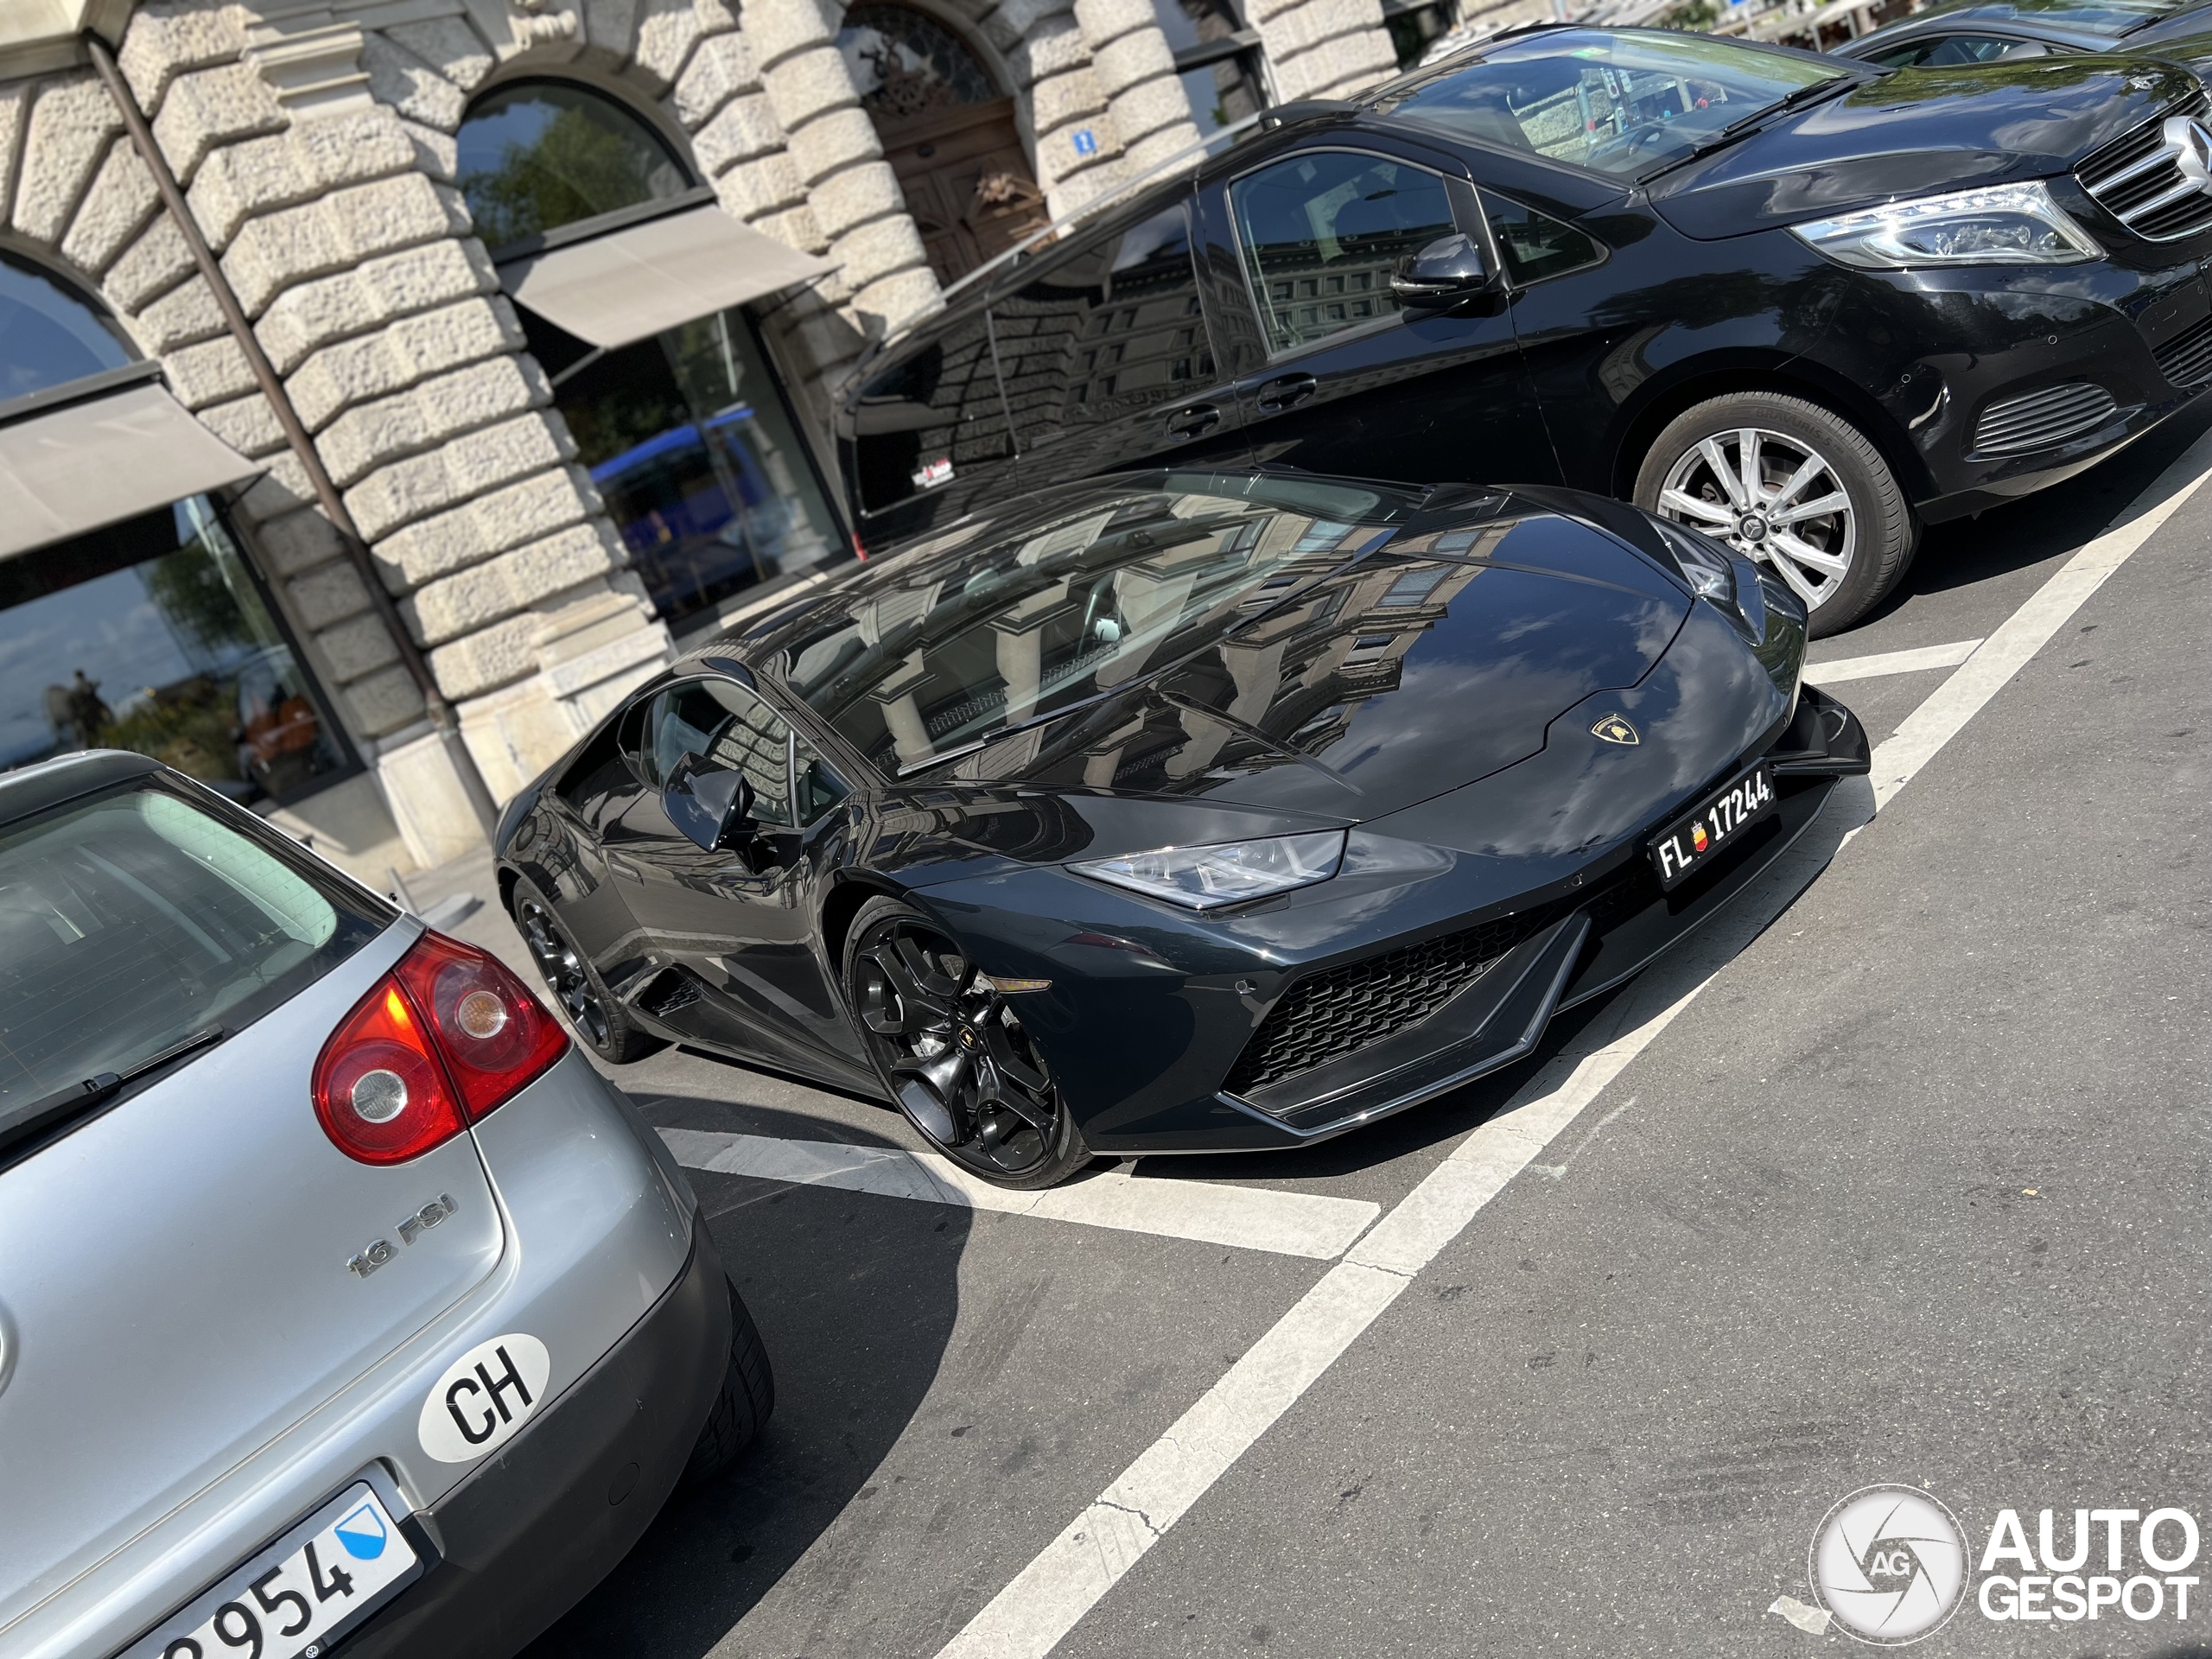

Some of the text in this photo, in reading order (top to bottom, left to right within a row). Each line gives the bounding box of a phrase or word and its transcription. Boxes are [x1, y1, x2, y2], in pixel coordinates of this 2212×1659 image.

[1756, 410, 1821, 438] BRAVURIS
[1822, 438, 1831, 447] 5
[1658, 771, 1770, 878] FL 17244
[395, 1192, 455, 1245] FSI
[446, 1344, 534, 1444] CH
